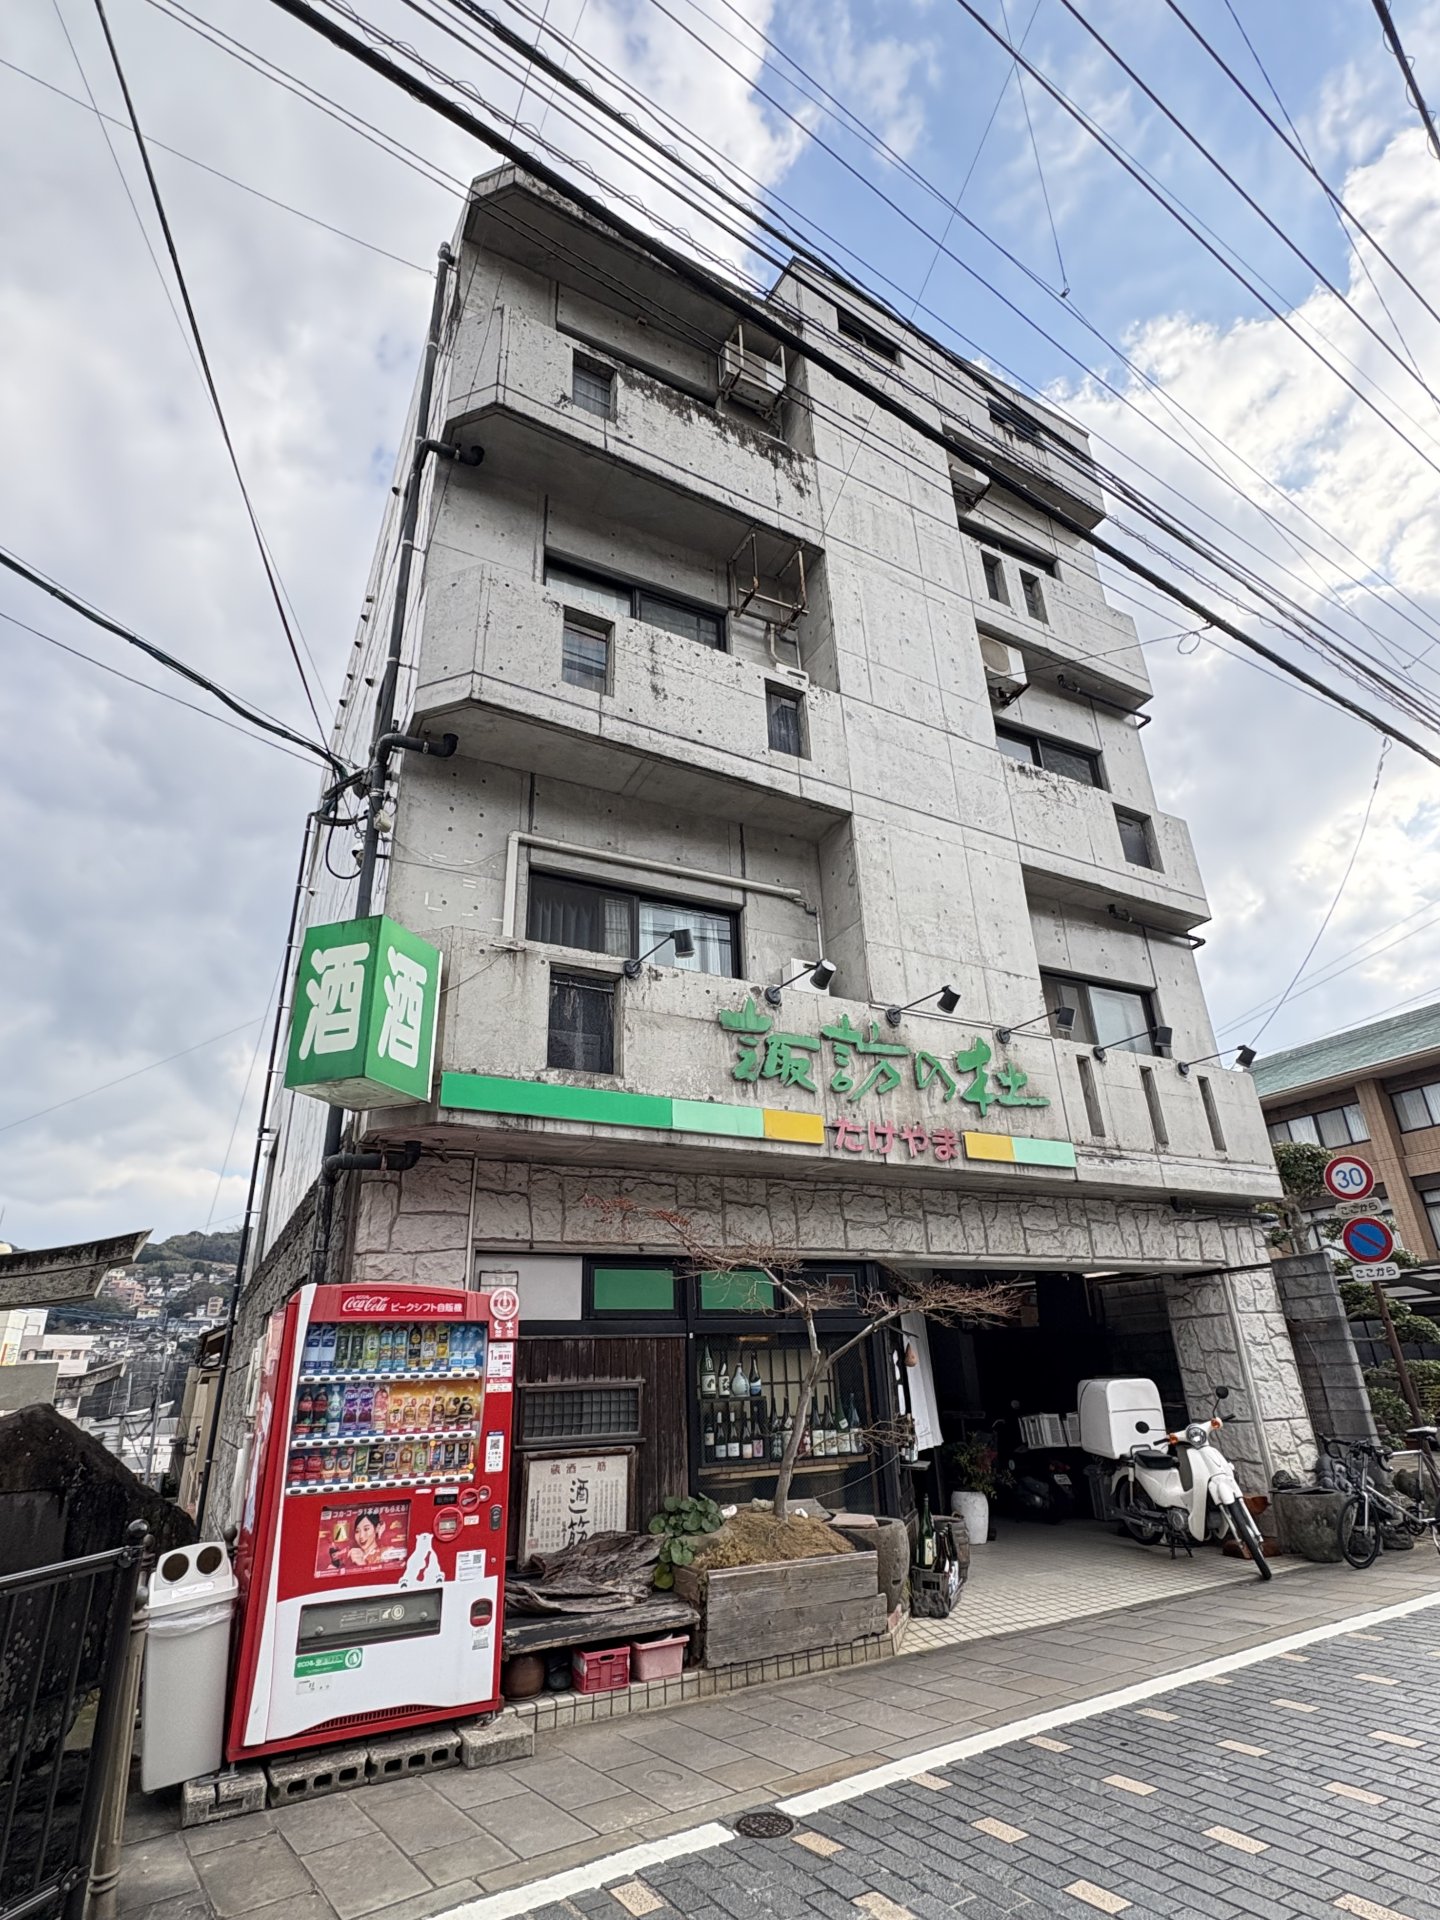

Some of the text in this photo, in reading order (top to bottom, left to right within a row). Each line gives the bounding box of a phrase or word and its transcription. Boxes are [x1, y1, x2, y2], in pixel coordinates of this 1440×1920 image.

[299, 942, 369, 1061] 酒
[378, 945, 428, 1069] 酒
[718, 996, 1051, 1117] 諏訪の杜
[833, 1117, 960, 1161] たけやま
[1336, 1167, 1364, 1189] 30
[1340, 1202, 1378, 1215] ここから
[1355, 1267, 1396, 1278] ここから
[391, 1303, 462, 1313] ピークシフト自販機
